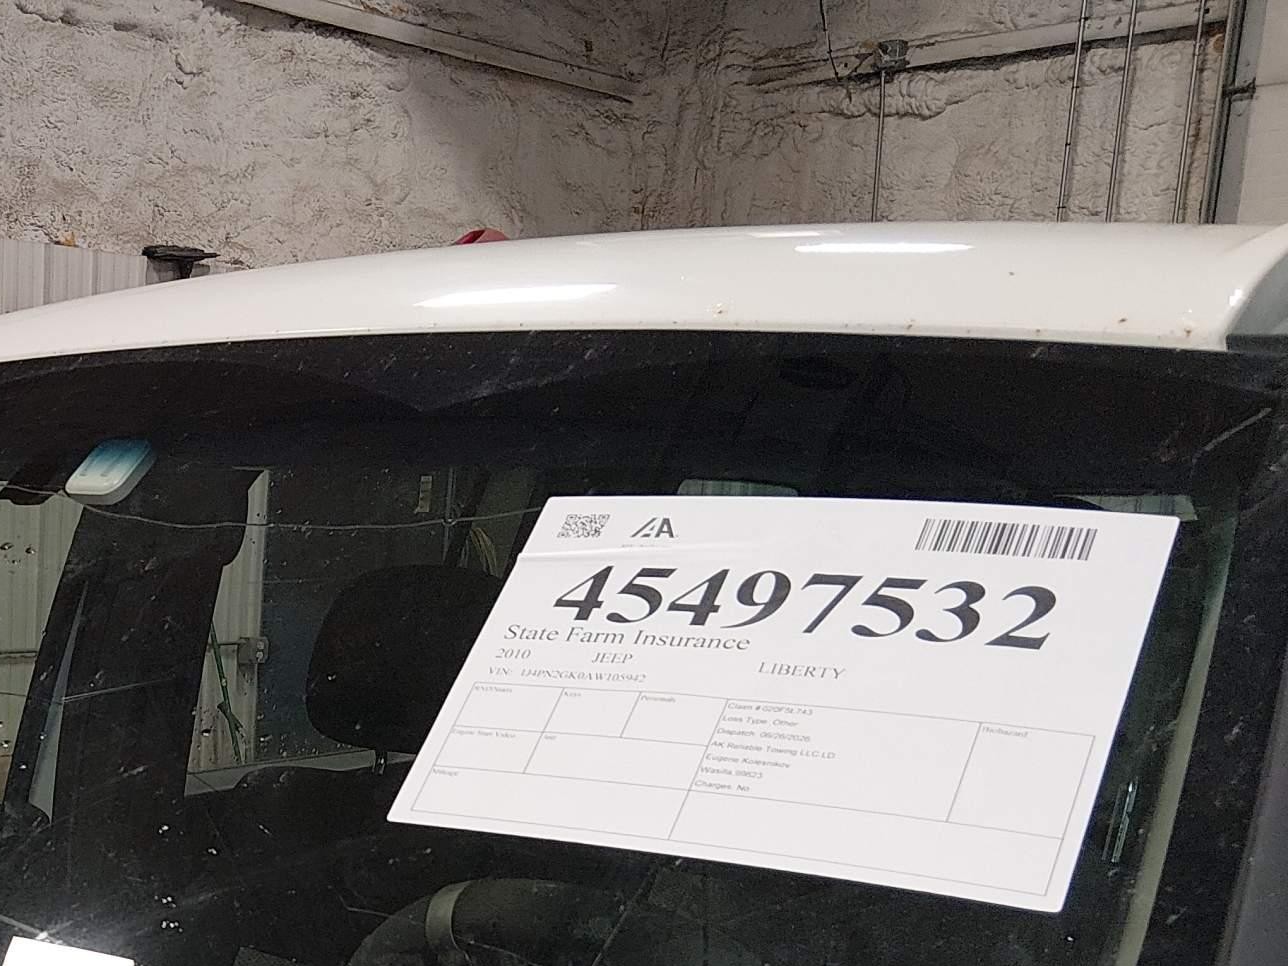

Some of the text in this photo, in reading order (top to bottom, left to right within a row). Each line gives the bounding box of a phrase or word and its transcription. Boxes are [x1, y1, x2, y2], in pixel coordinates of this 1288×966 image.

[553, 564, 1060, 651] 45497532
[503, 623, 751, 652] State Farm Insurance
[494, 648, 847, 680] 2010 JEEP LIBERTY
